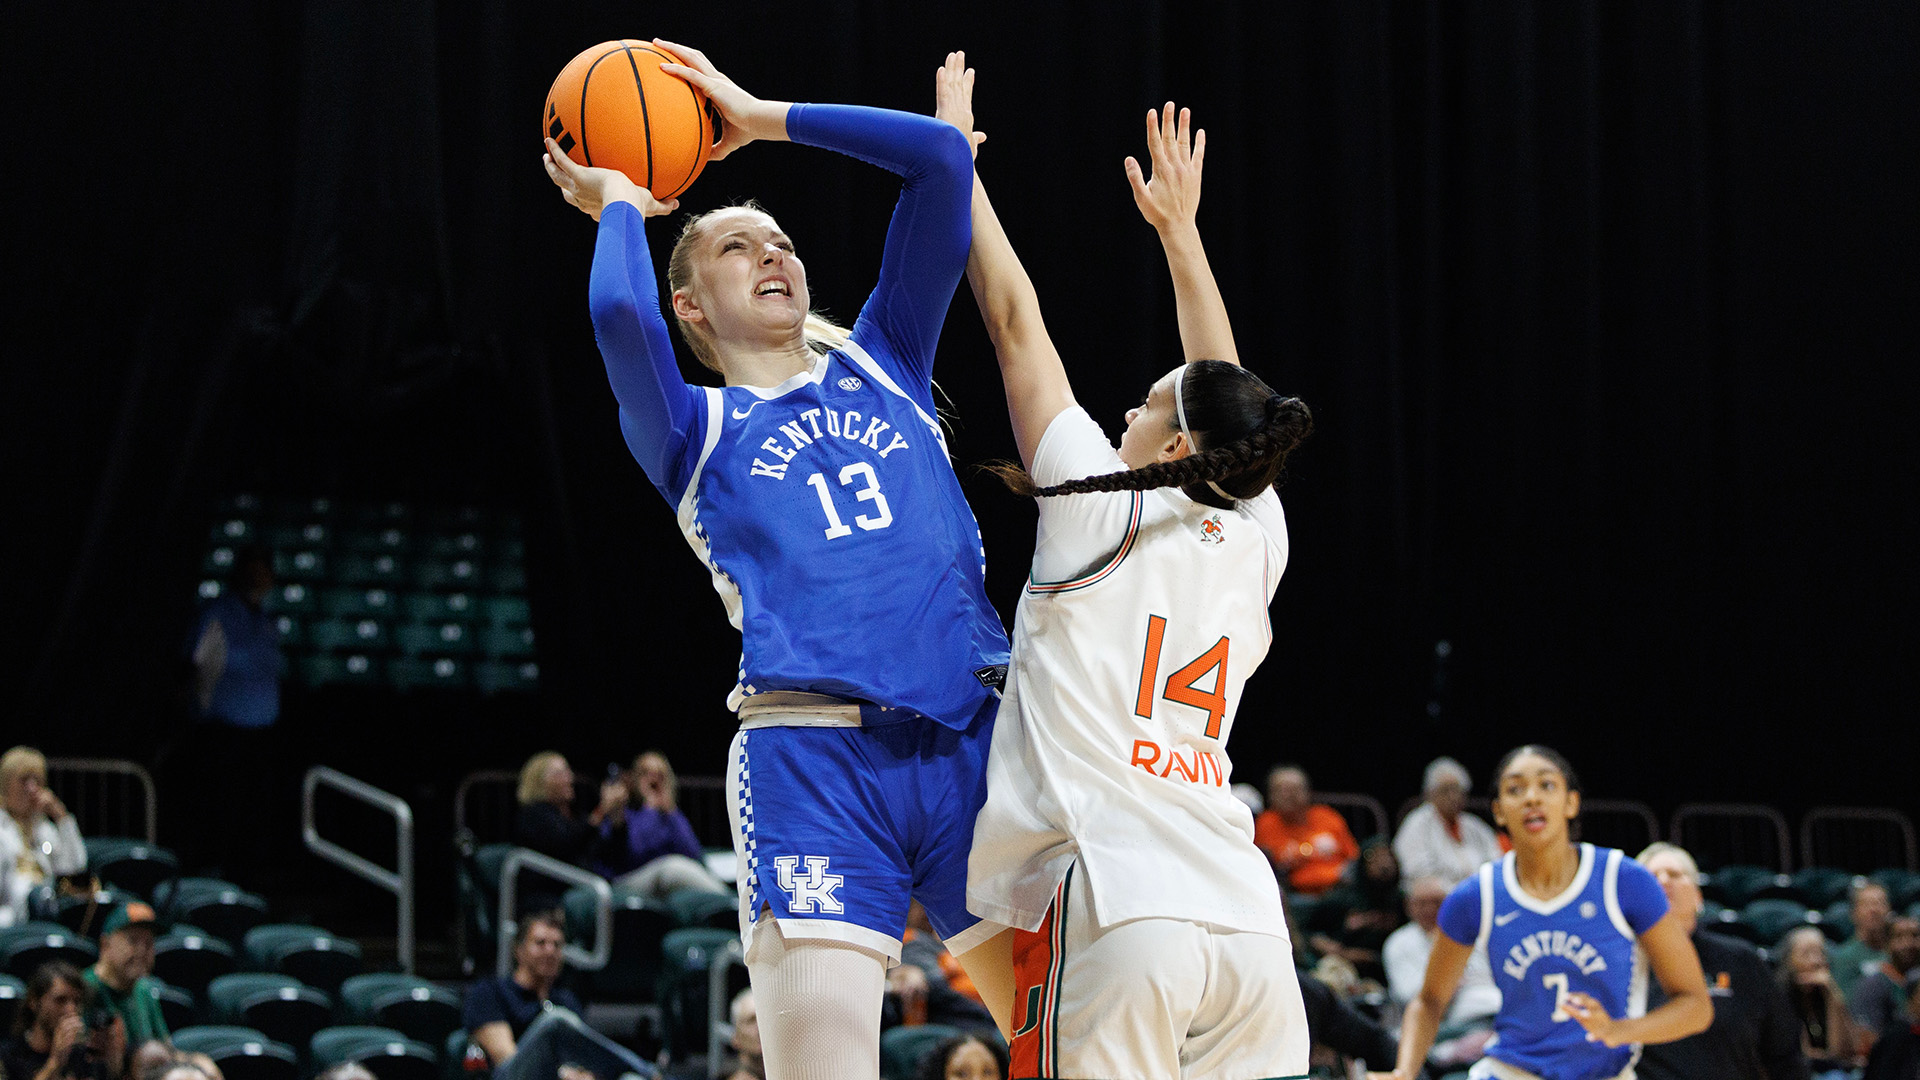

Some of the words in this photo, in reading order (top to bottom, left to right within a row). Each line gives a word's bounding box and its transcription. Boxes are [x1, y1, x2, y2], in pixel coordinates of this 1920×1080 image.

[751, 407, 909, 480] KENTUCKY
[807, 461, 893, 541] 13
[1135, 614, 1230, 739] 14
[774, 855, 844, 915] UK
[1504, 931, 1607, 981] KENTUCKY
[1543, 973, 1570, 1022] 7
